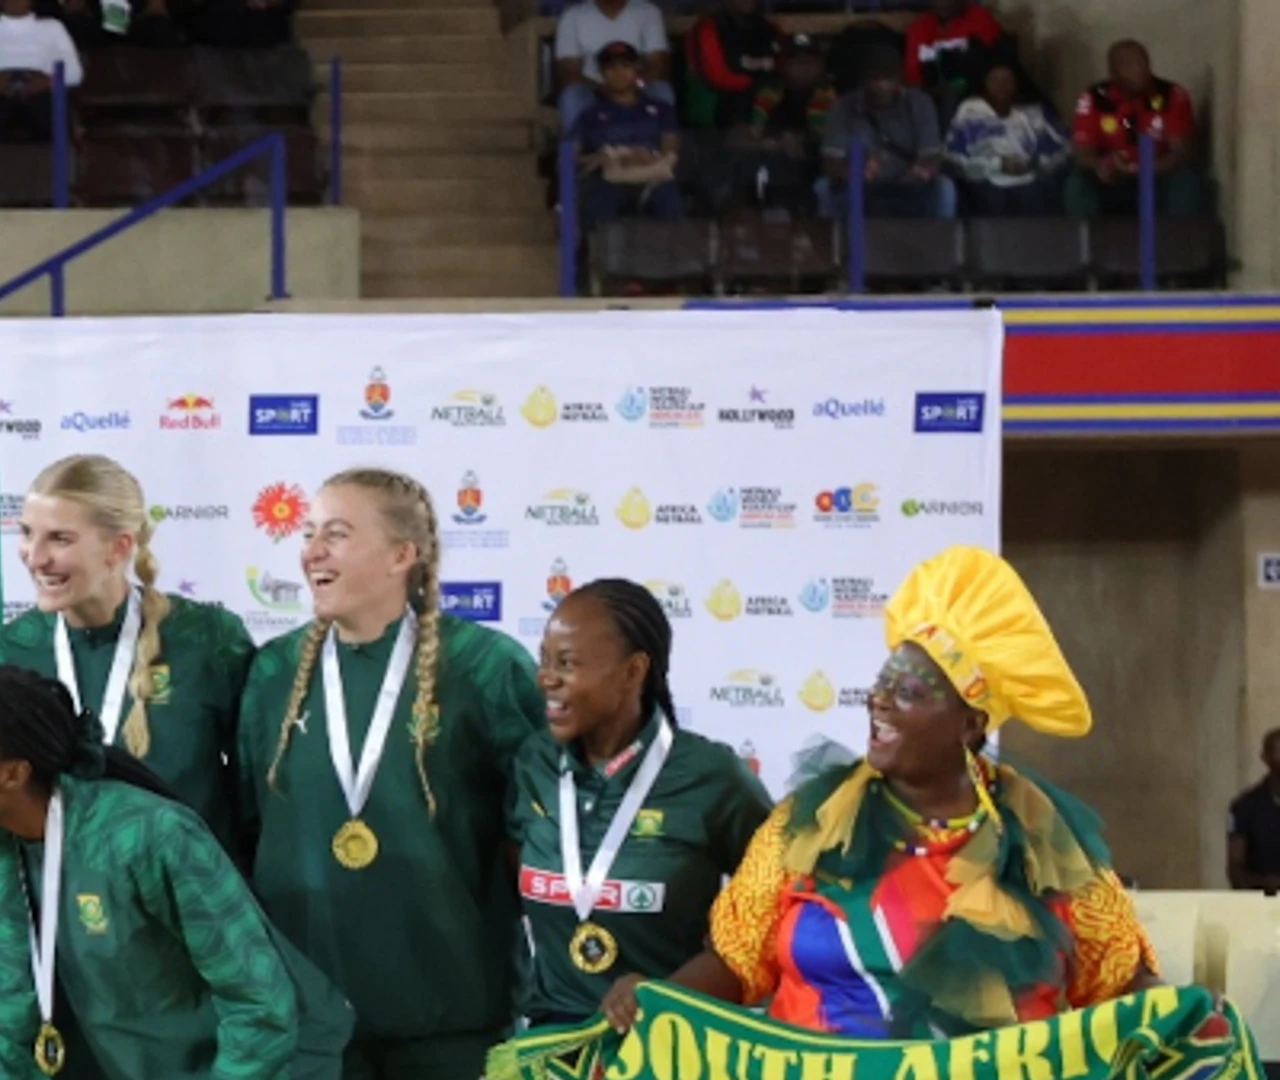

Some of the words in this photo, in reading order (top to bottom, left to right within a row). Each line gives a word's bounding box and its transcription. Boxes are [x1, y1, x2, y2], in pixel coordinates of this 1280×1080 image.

[159, 415, 189, 430] Red
[192, 414, 221, 430] Bull
[718, 409, 795, 423] HOLLYWOOD
[530, 876, 620, 905] SPR
